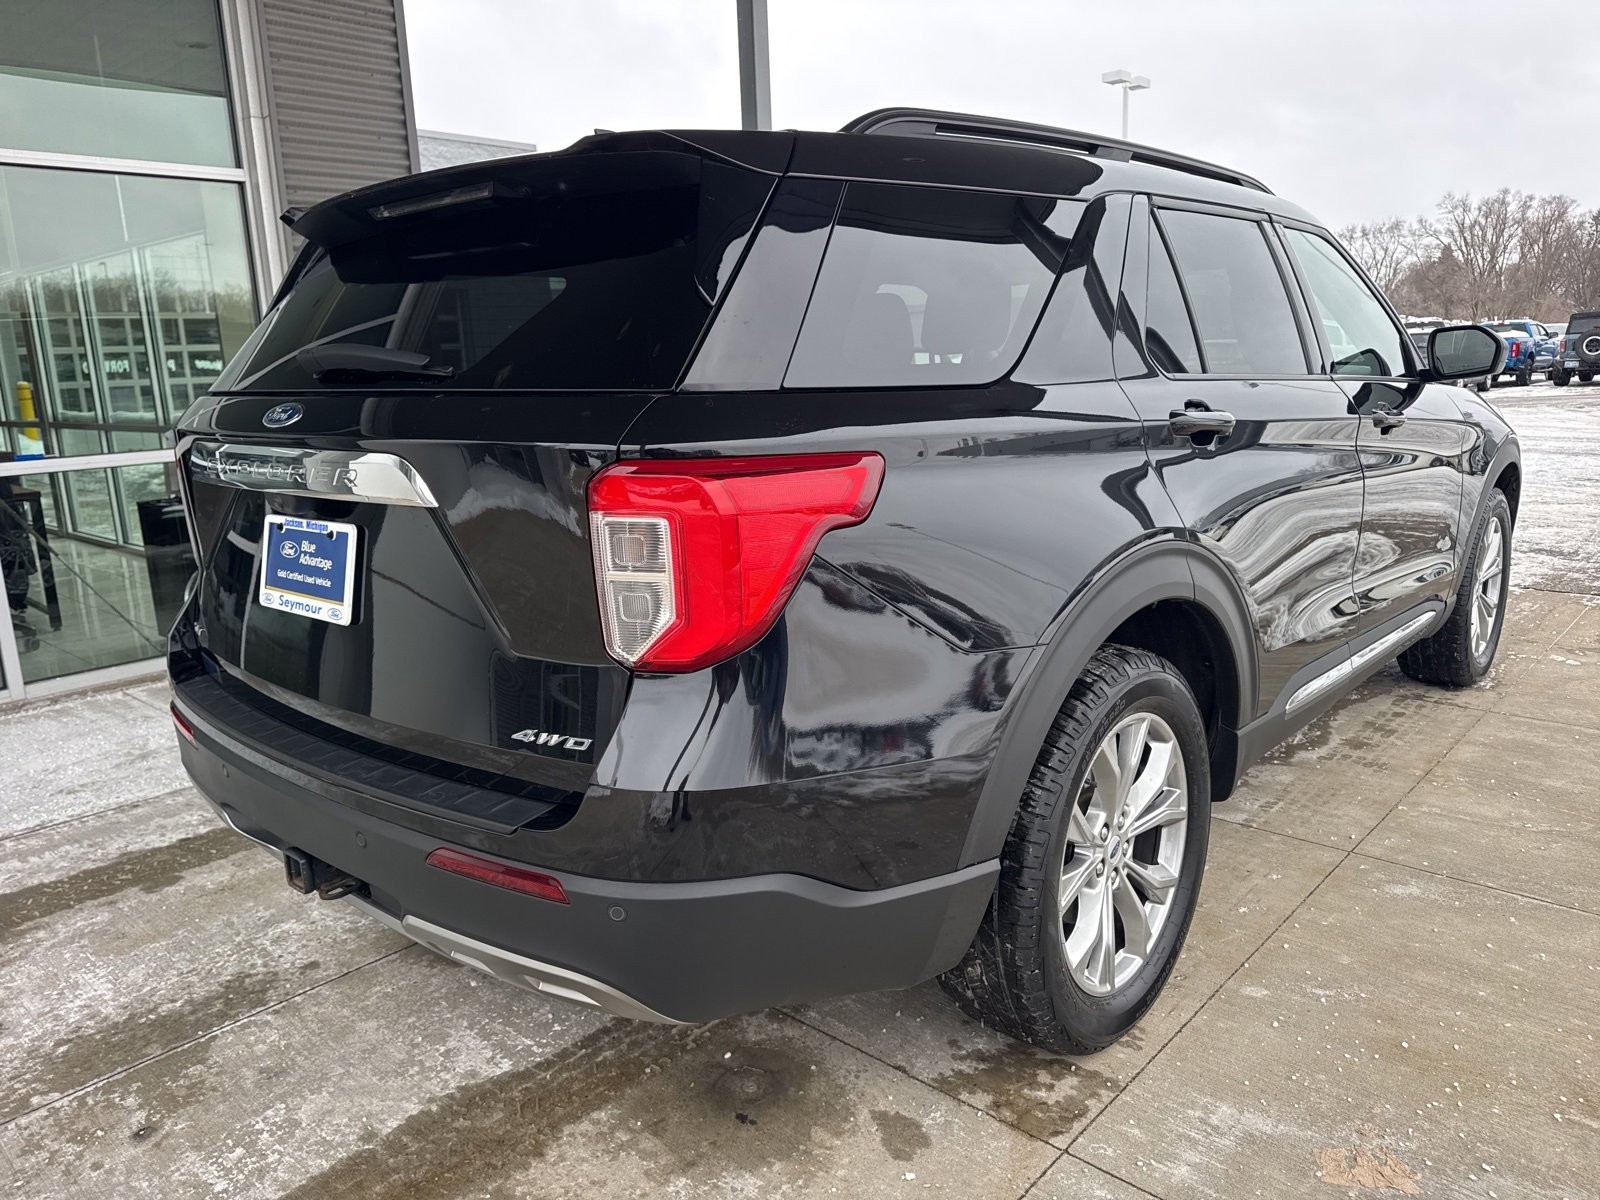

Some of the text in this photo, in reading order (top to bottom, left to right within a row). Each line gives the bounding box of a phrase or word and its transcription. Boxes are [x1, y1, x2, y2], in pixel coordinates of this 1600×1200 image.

[268, 406, 294, 421] Ford
[206, 456, 359, 487] EXPLORER
[306, 520, 329, 533] Michigan
[282, 541, 297, 556] Ford
[300, 540, 316, 553] Blue
[299, 553, 332, 571] Advantage
[277, 568, 332, 588] Gold Certified Used Vehicle
[279, 594, 322, 615] Seymour
[511, 729, 593, 751] 4WD
